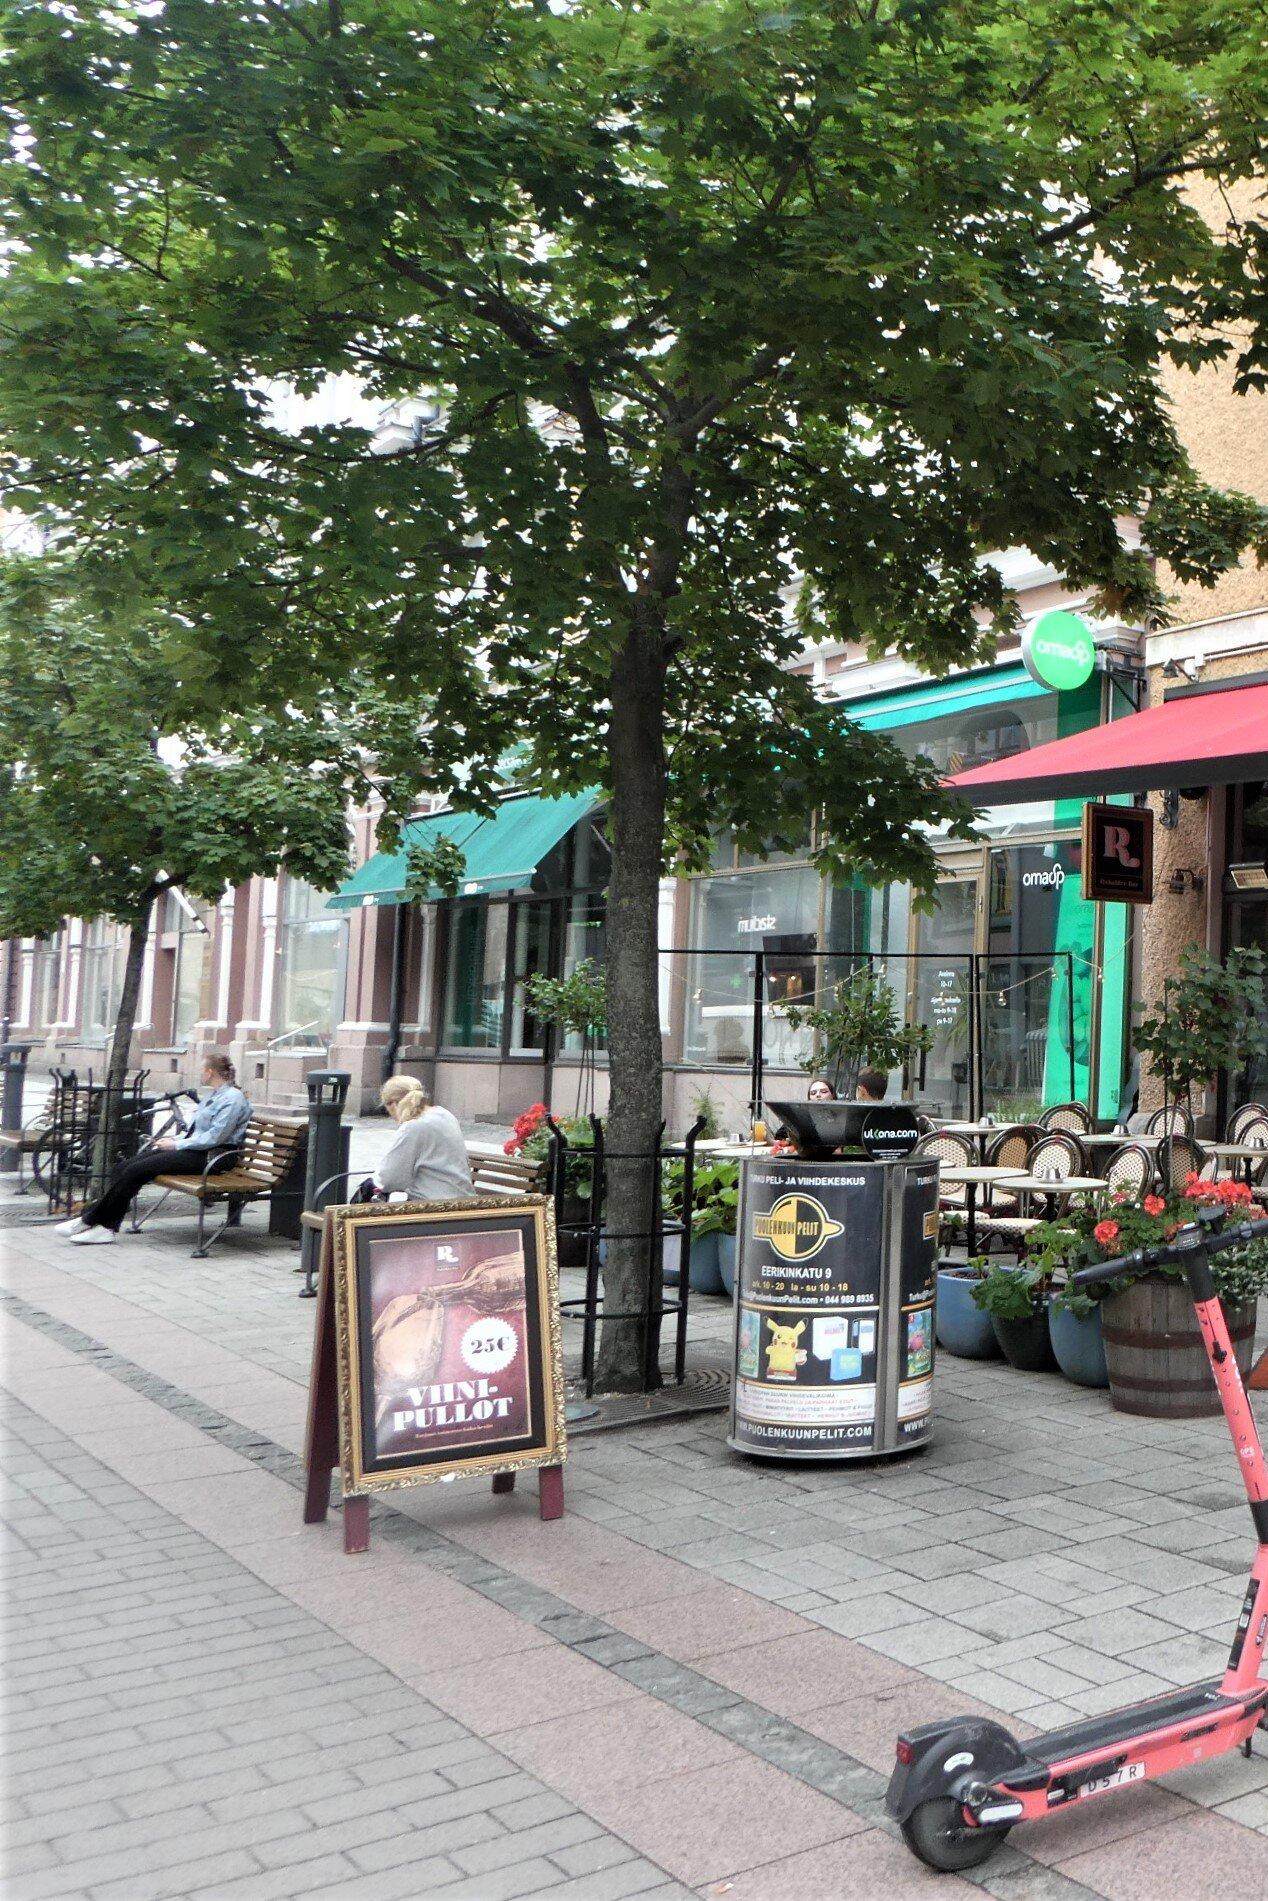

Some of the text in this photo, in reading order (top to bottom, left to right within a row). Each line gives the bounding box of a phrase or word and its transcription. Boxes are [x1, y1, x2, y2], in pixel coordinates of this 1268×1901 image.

[1103, 825, 1141, 868] R
[785, 1176, 797, 1185] JA
[797, 1176, 866, 1186] VIIHDEKESKUS
[797, 1221, 819, 1235] PELIT
[761, 1265, 832, 1279] EERIKINKATU 9
[470, 1335, 510, 1355] 25€
[405, 1377, 499, 1408] VIINI-
[391, 1395, 514, 1432] PULLOT
